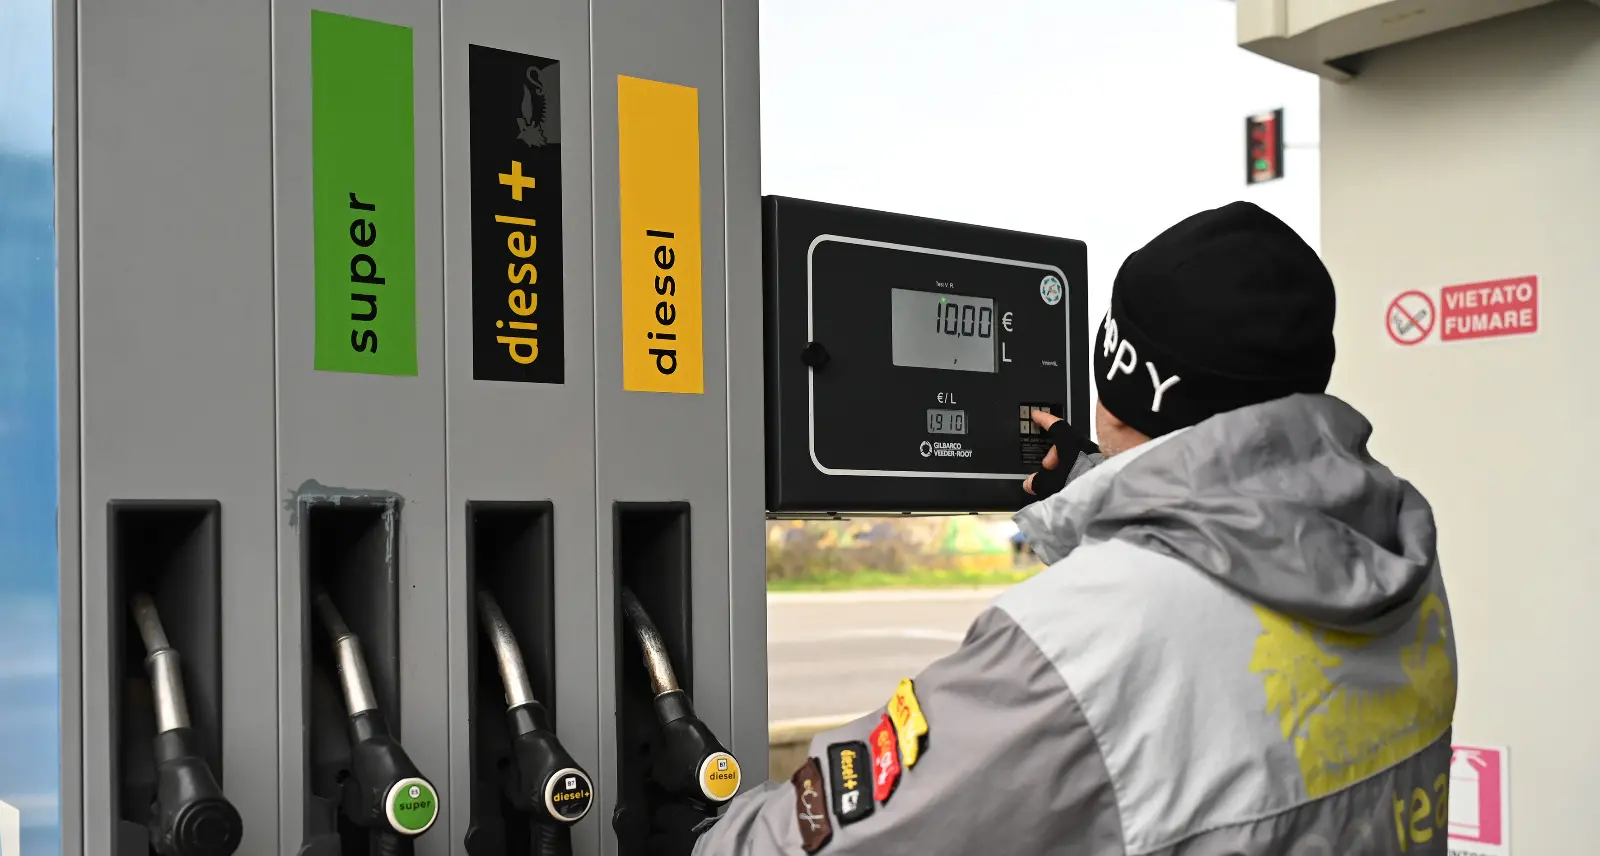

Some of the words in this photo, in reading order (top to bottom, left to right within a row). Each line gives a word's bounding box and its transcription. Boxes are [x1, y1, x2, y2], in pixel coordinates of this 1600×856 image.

[348, 191, 386, 355] super
[646, 229, 678, 376] diesel
[1444, 282, 1533, 310] VIETATO
[936, 302, 993, 339] 10,00
[1001, 311, 1014, 333] €
[1444, 308, 1534, 335] FUMARE
[1002, 341, 1012, 363] L
[933, 441, 962, 450] GILBARCO
[933, 448, 973, 458] VEEDER-ROOT
[709, 771, 736, 781] diesel
[399, 800, 432, 812] super
